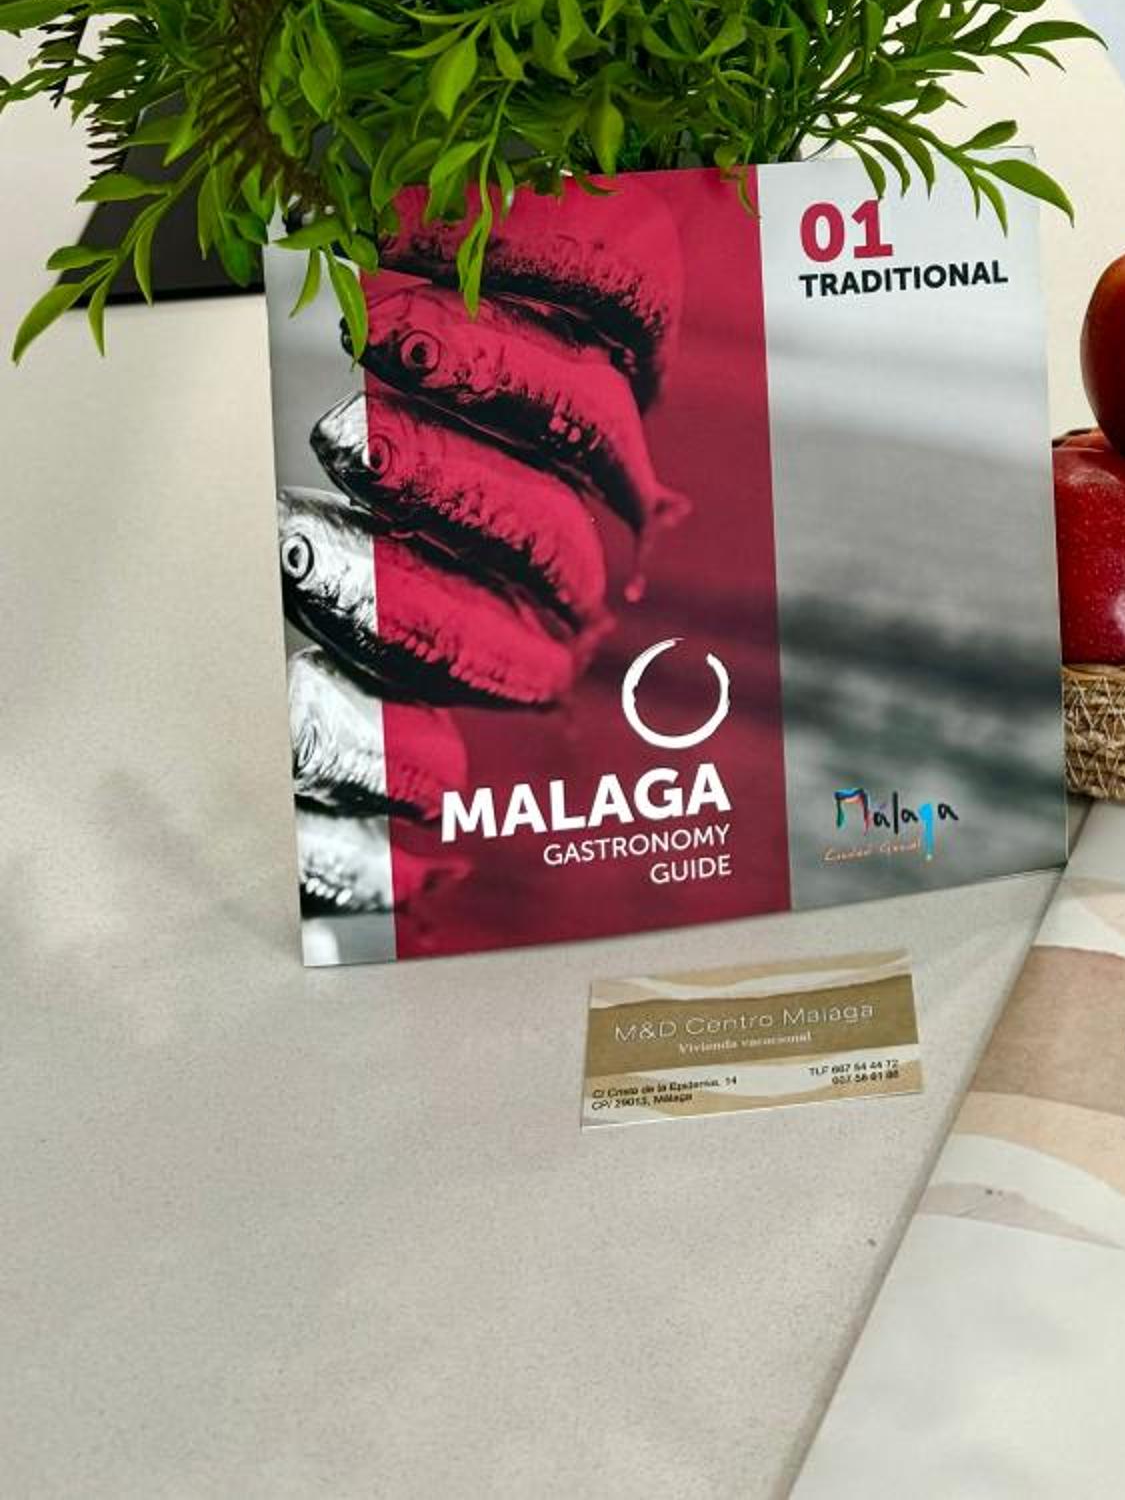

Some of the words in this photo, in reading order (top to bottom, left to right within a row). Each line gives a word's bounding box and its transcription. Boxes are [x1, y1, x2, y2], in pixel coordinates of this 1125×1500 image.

[800, 198, 894, 263] 01
[798, 260, 1009, 298] TRADITIONAL
[441, 763, 733, 843] MALAGA
[543, 823, 731, 866] GASTRONOMY
[650, 854, 732, 885] GUIDE
[615, 1020, 677, 1042] M&D
[686, 1012, 773, 1036] Centro
